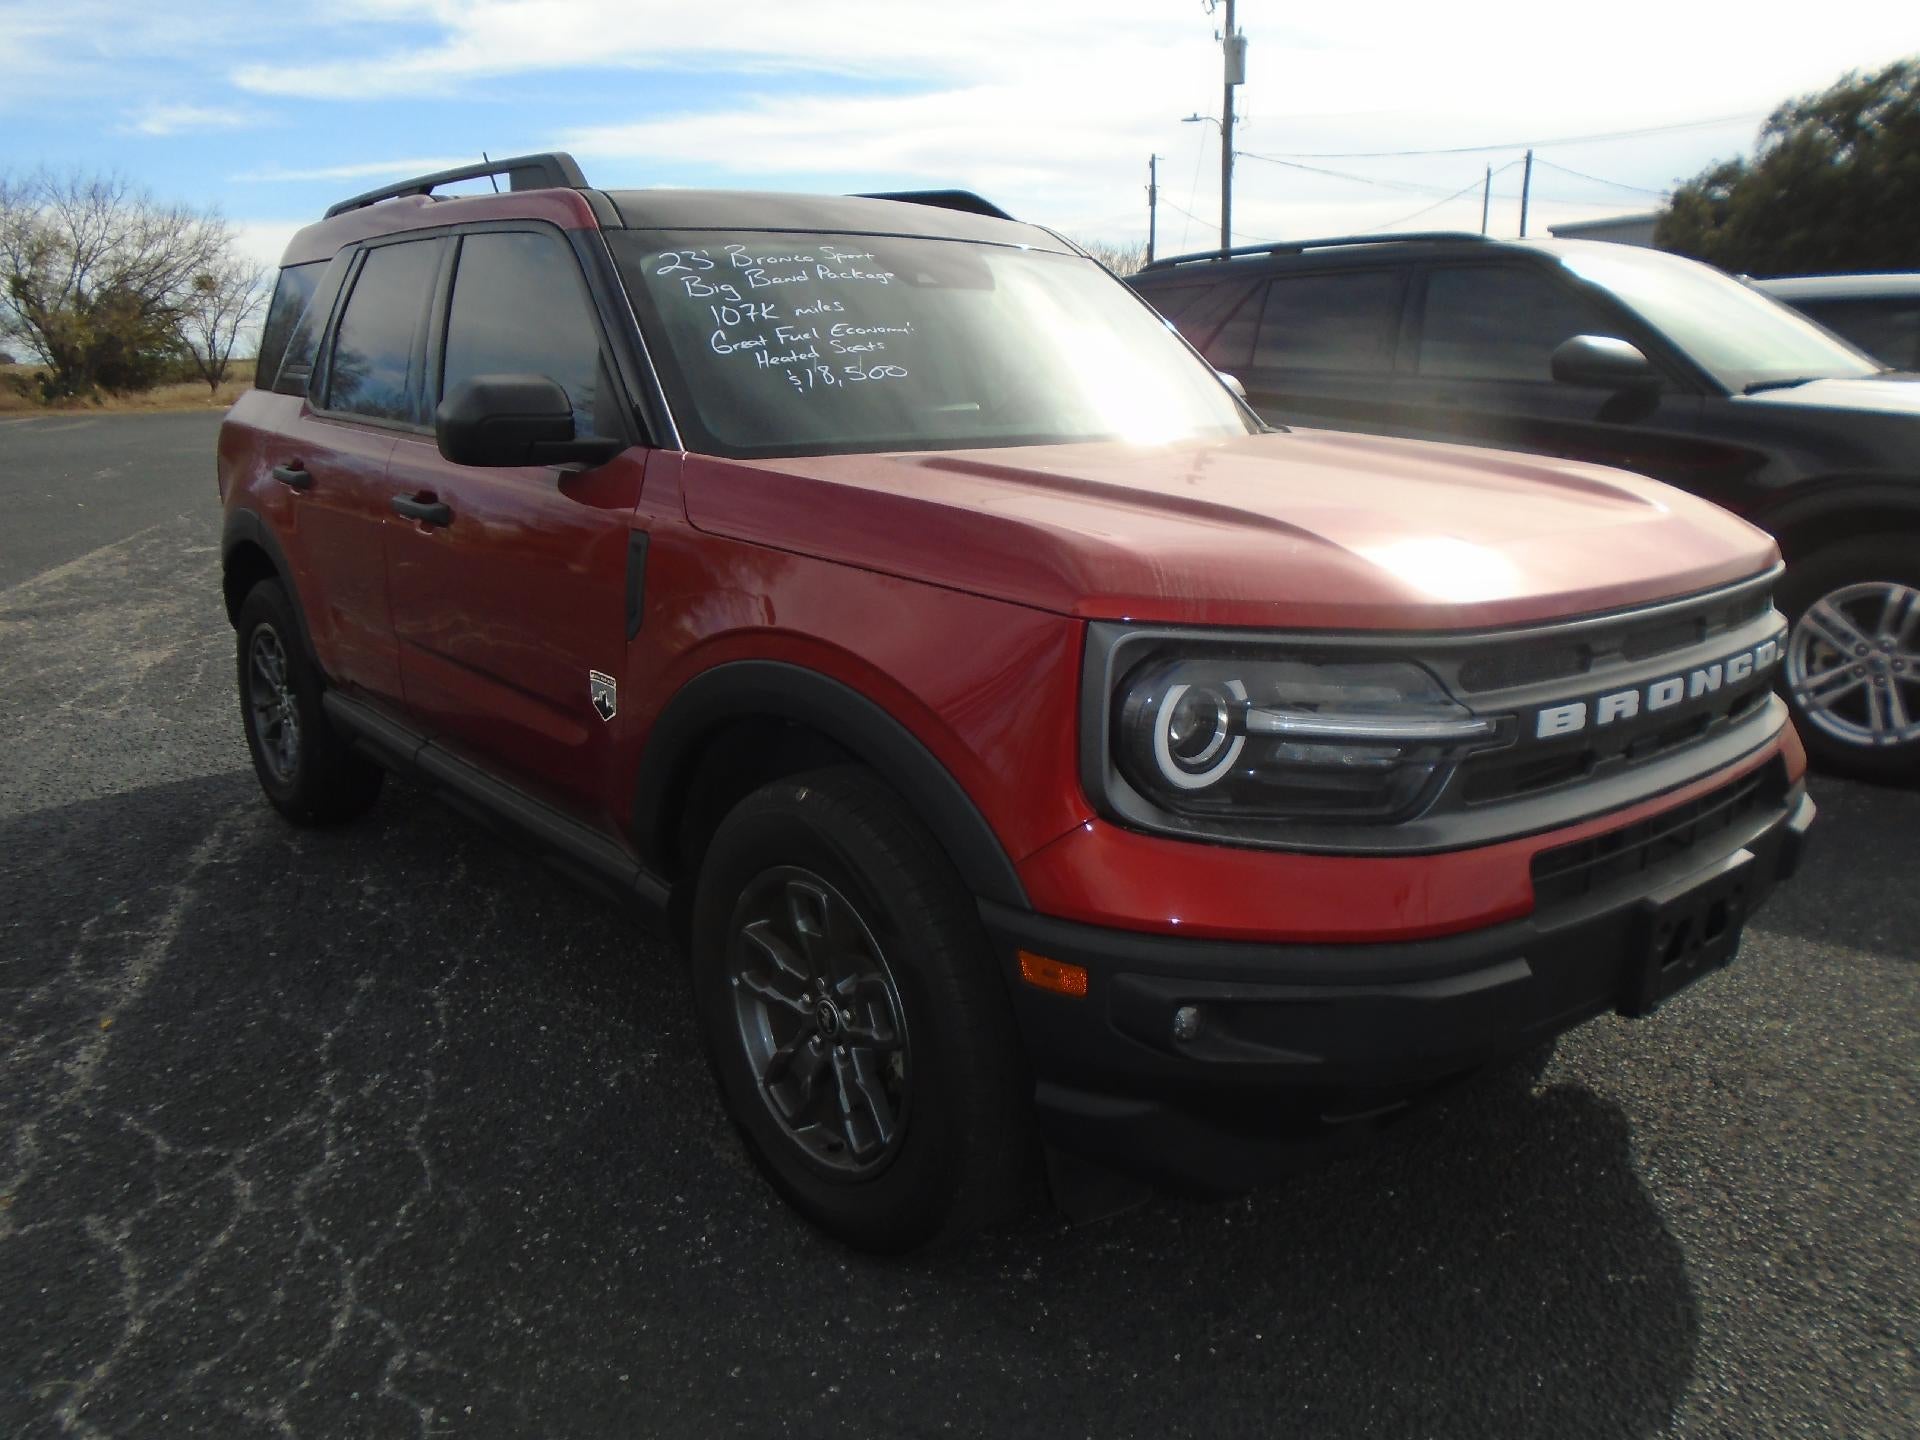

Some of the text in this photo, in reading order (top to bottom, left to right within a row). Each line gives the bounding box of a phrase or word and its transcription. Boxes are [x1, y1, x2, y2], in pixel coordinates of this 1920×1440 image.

[724, 244, 815, 267] Bronco
[818, 246, 876, 264] Sport
[679, 263, 896, 302] Big Bend Package
[710, 299, 846, 326] 107K miles
[710, 329, 768, 355] Great
[775, 326, 821, 345] Fuel
[755, 339, 887, 369] Heated Seats
[786, 365, 909, 393] $18,500
[1536, 639, 1778, 740] BRONCO
